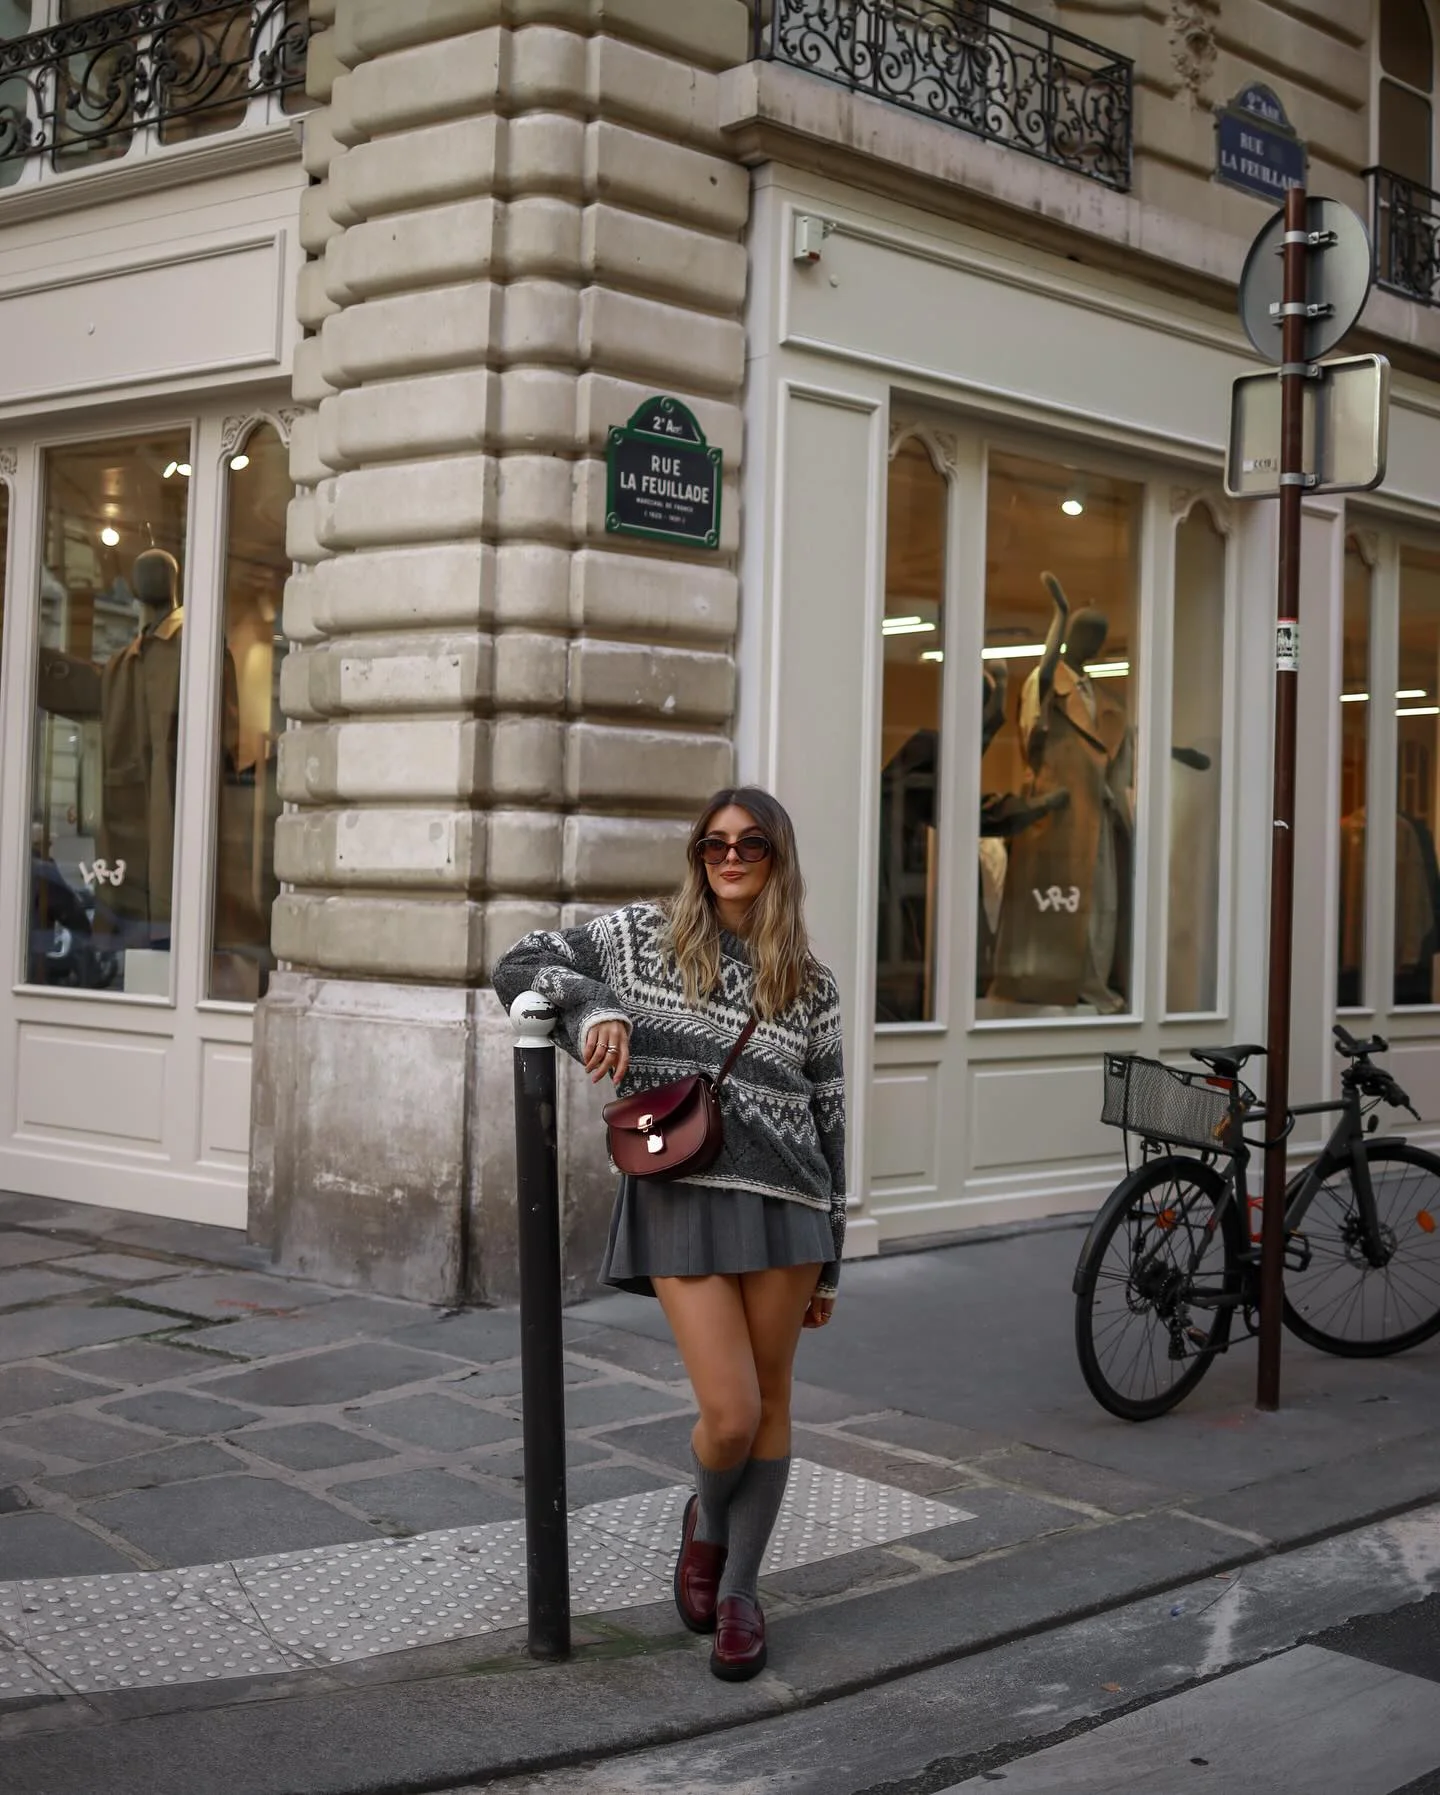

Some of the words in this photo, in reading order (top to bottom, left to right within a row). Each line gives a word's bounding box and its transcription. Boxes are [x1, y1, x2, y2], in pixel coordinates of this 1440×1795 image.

[1240, 132, 1264, 155] RUE
[1221, 149, 1238, 170] LA
[651, 454, 681, 477] RUE
[620, 471, 637, 491] LA
[641, 475, 710, 504] FEUILLADE
